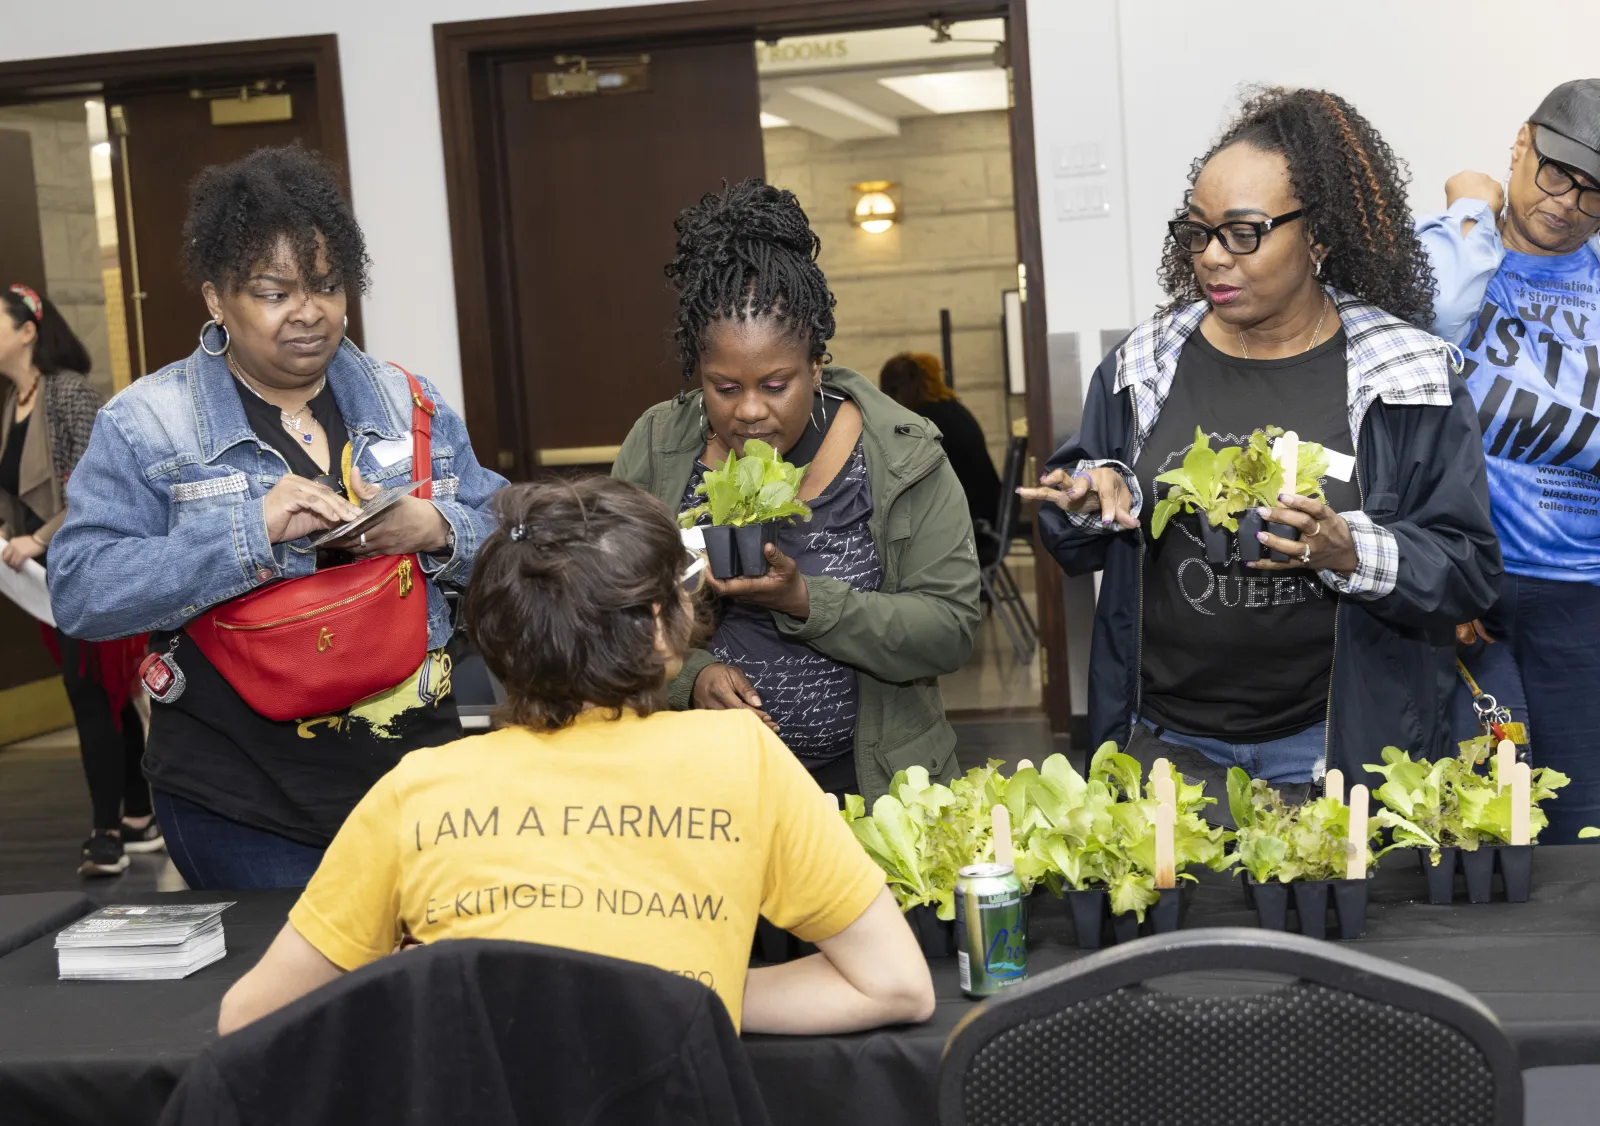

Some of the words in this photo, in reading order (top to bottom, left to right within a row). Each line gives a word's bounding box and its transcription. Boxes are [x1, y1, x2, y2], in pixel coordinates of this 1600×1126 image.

[1528, 291, 1597, 311] Storytellers
[1539, 500, 1598, 516] tellers.com
[1542, 488, 1600, 506] blackstory
[1177, 557, 1324, 615] QUEEN
[415, 821, 423, 852] I
[434, 806, 499, 845] AM
[516, 806, 545, 836] A
[563, 805, 740, 843] FARMER.
[426, 884, 584, 925] E-KITIGED
[597, 888, 728, 922] NDAAW.
